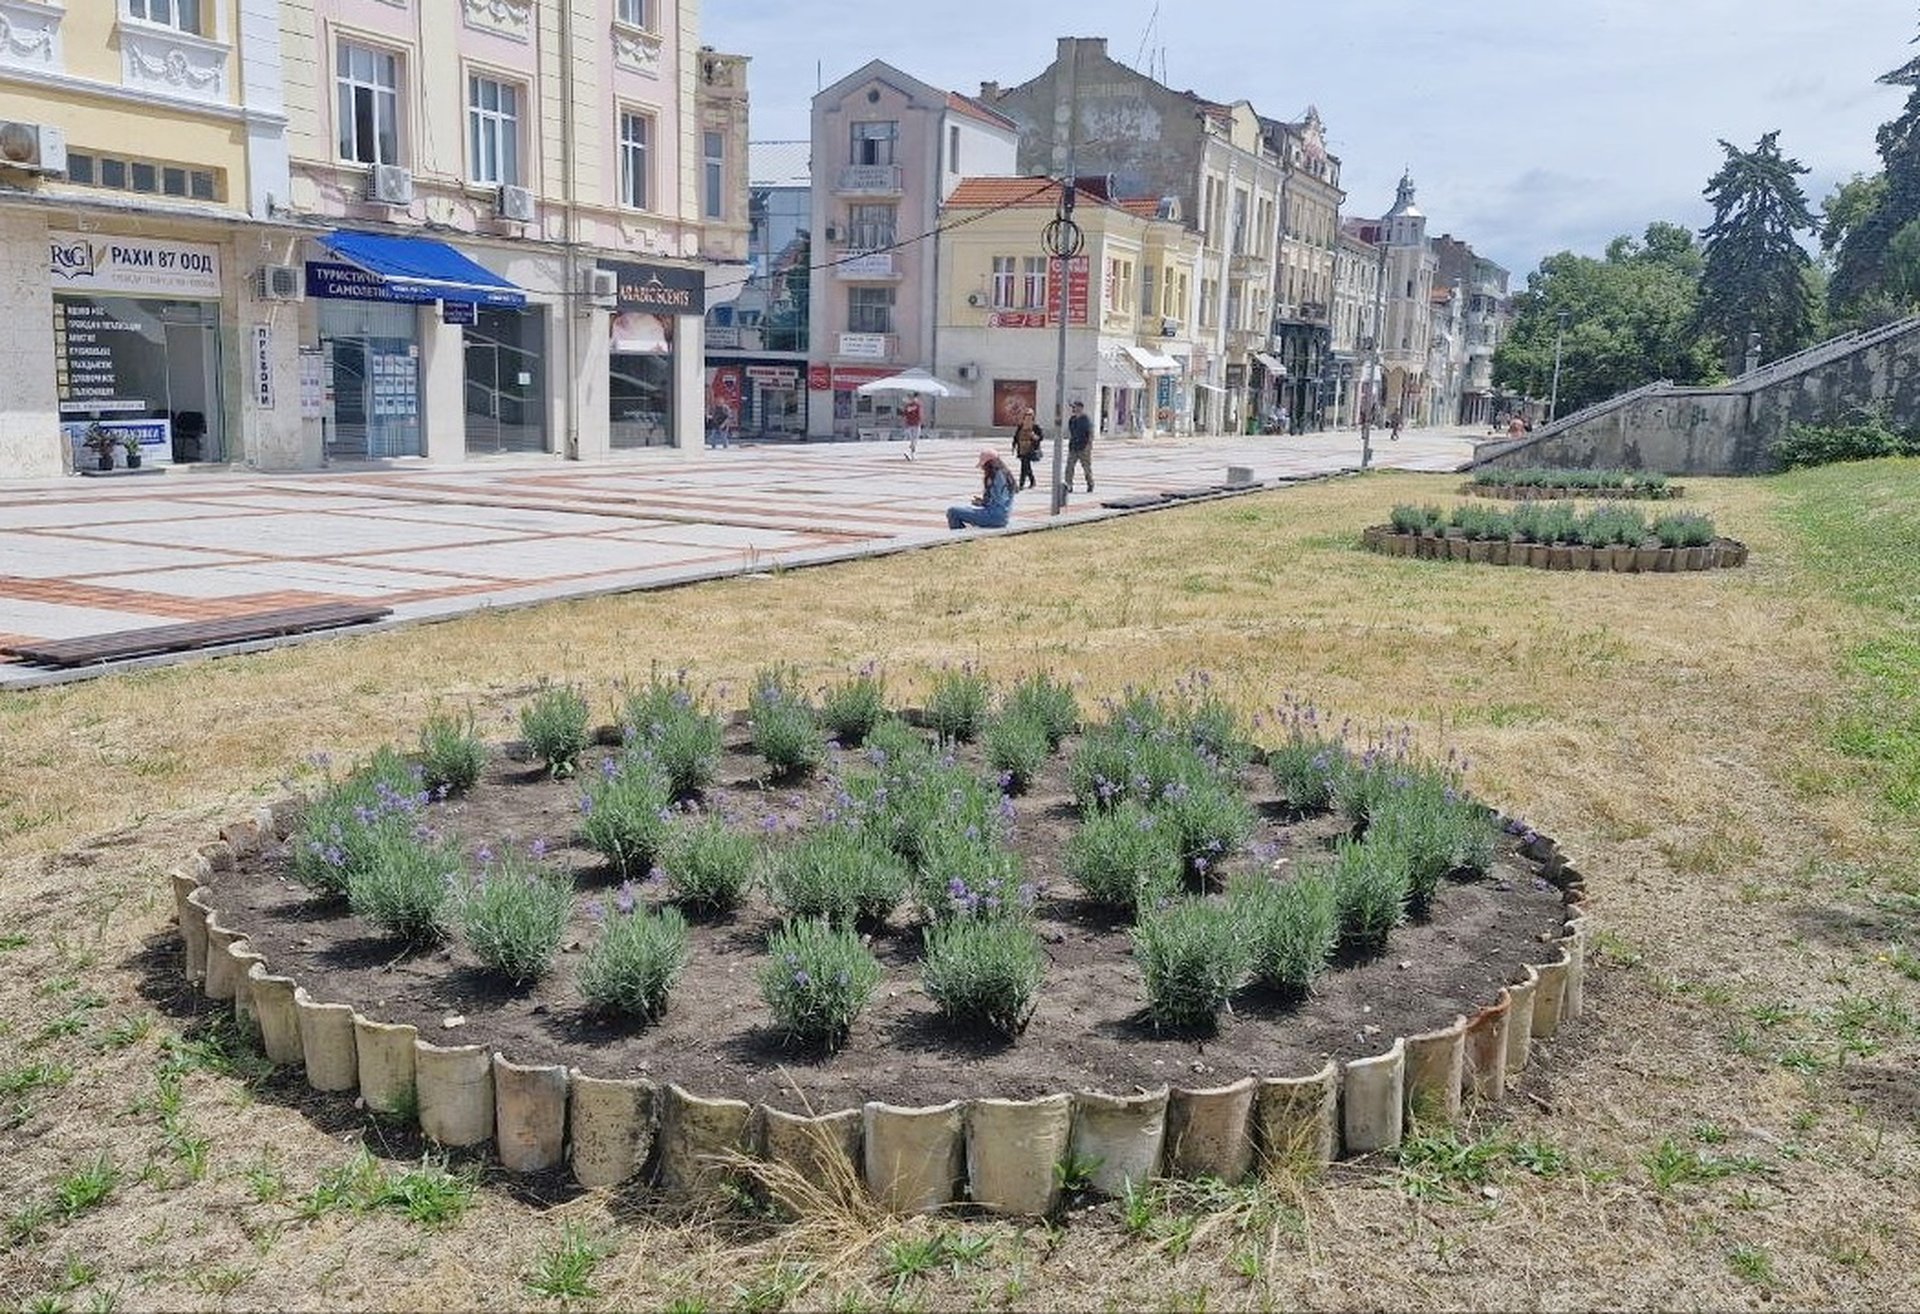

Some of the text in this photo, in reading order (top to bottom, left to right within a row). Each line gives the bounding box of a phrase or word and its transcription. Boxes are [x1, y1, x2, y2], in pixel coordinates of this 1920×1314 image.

[111, 246, 214, 274] РАХИ 87 ООД
[258, 328, 269, 405] ПРЕВОДИ
